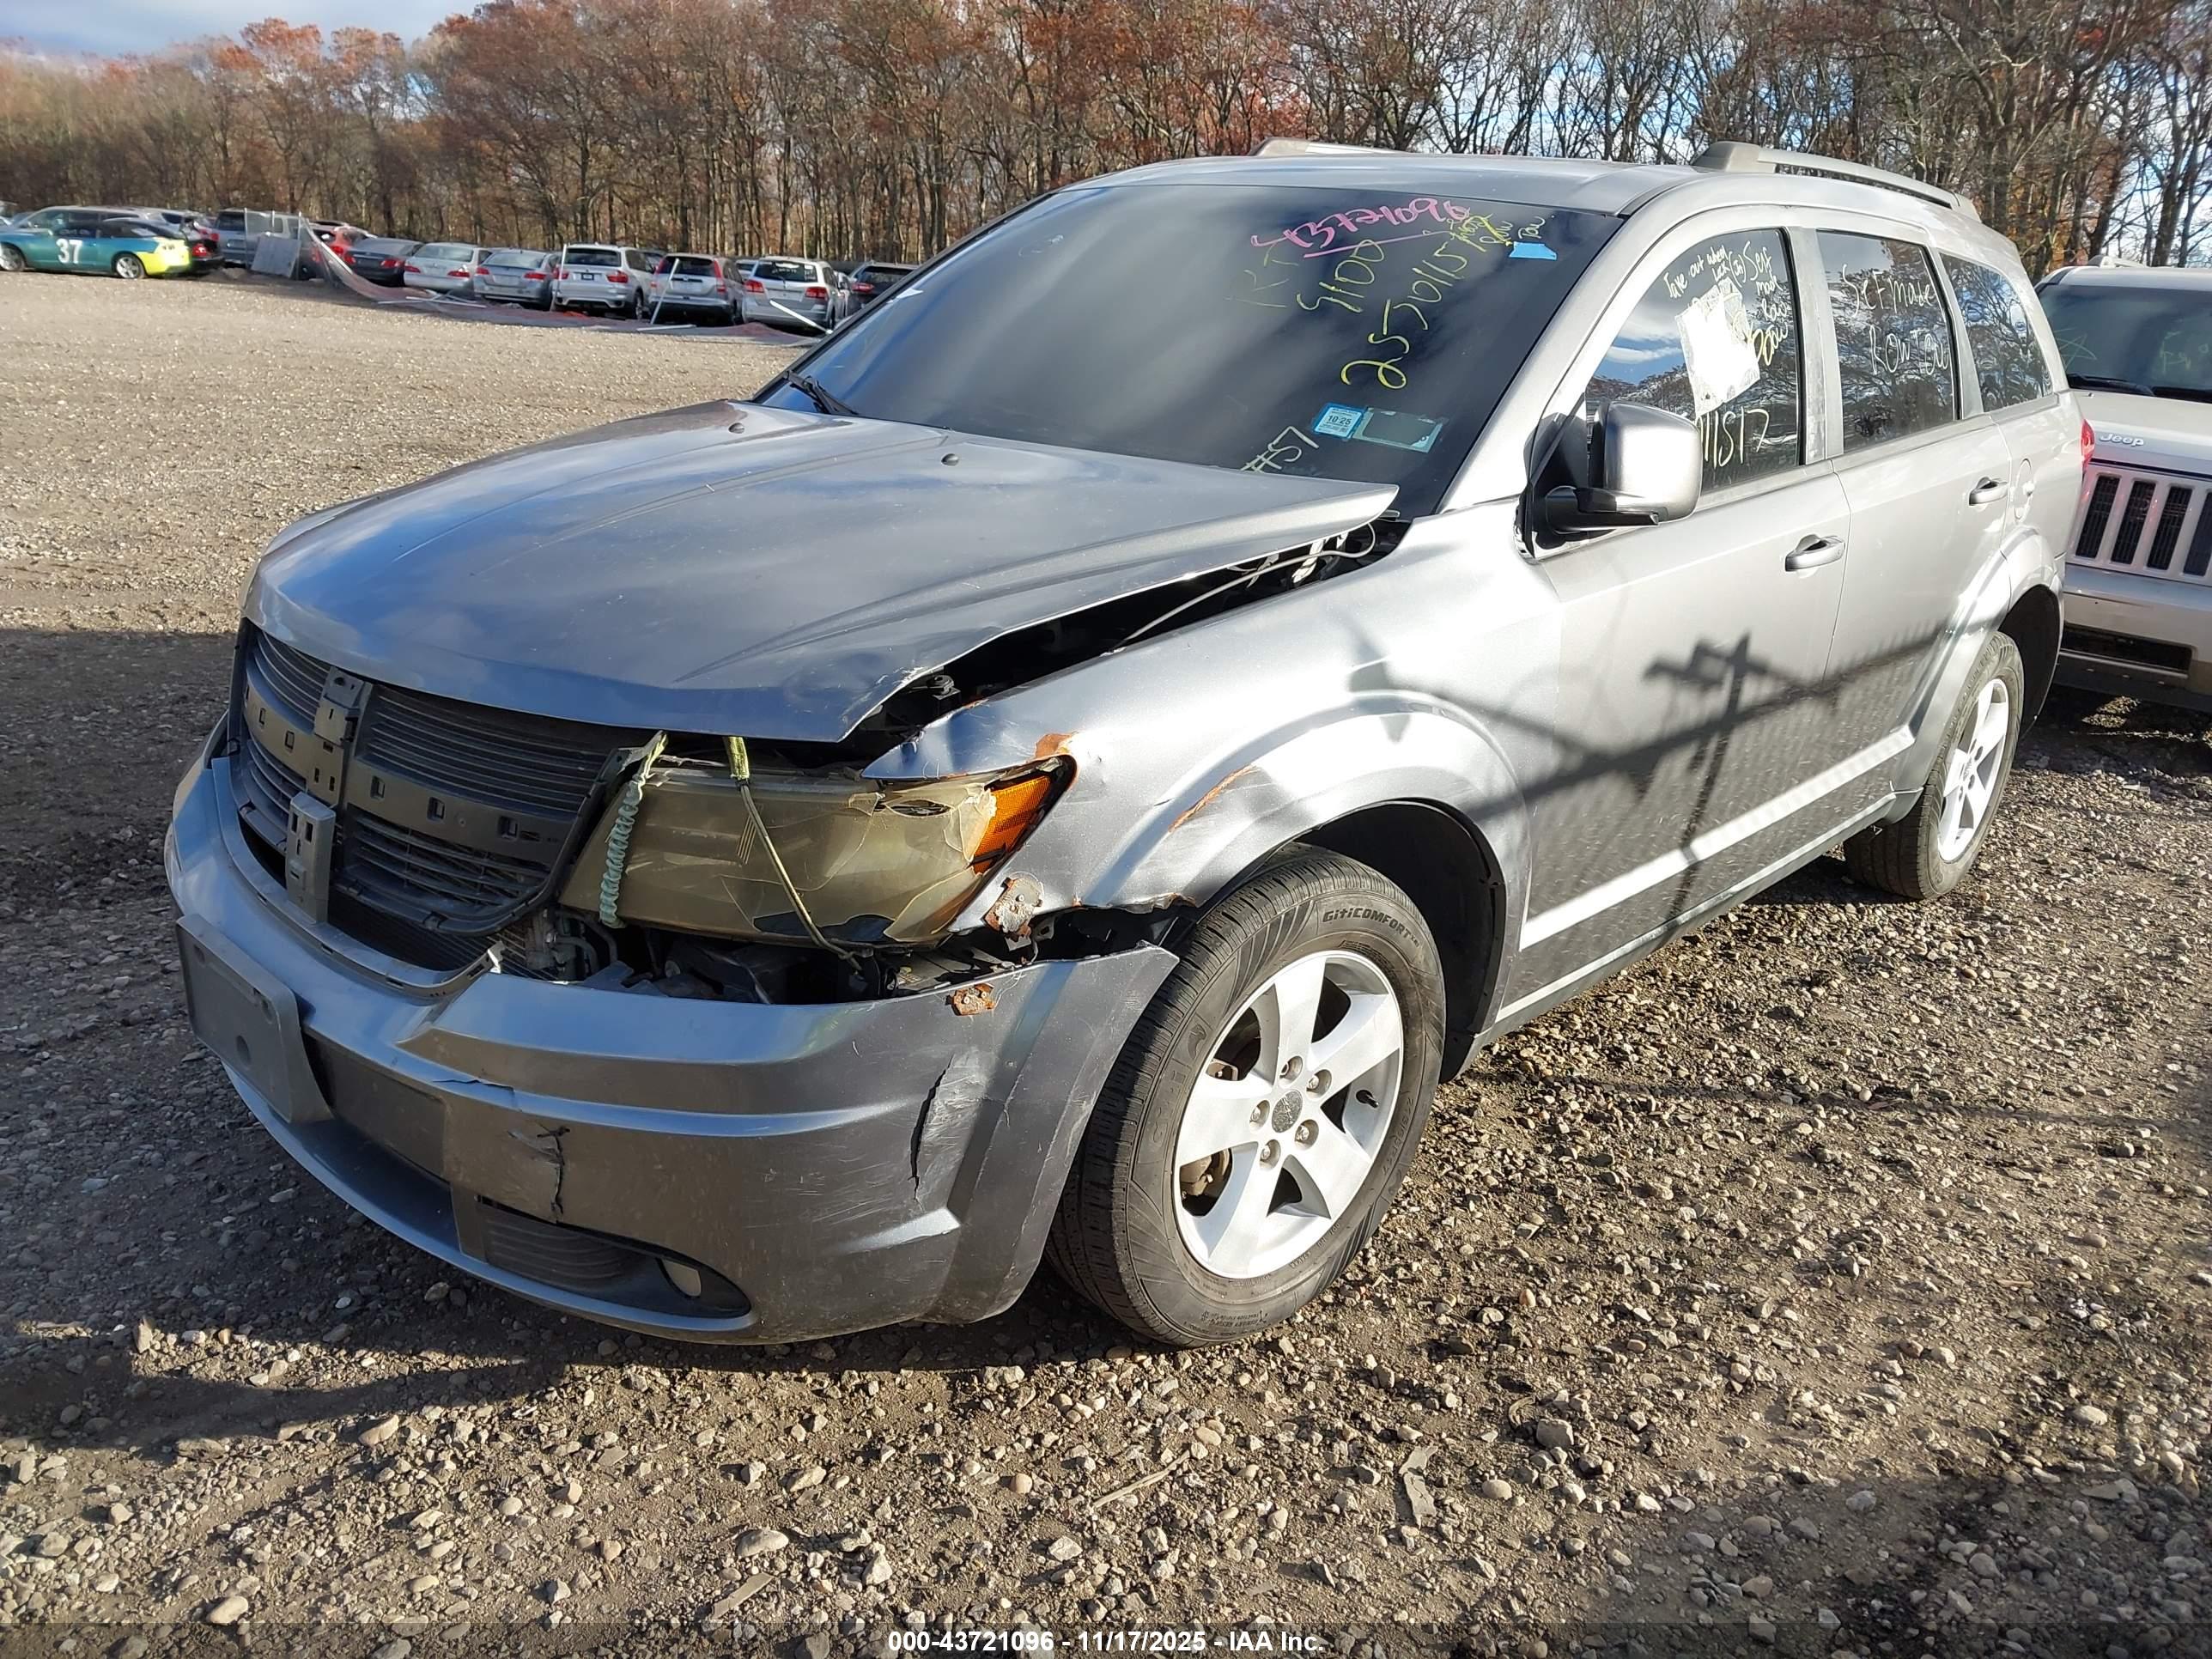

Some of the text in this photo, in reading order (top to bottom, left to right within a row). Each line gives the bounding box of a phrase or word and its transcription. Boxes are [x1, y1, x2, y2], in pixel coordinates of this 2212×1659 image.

[56, 238, 82, 264] 37
[1689, 254, 1705, 278] out
[1328, 415, 1352, 426] 10 25
[2099, 433, 2145, 447] Jeep
